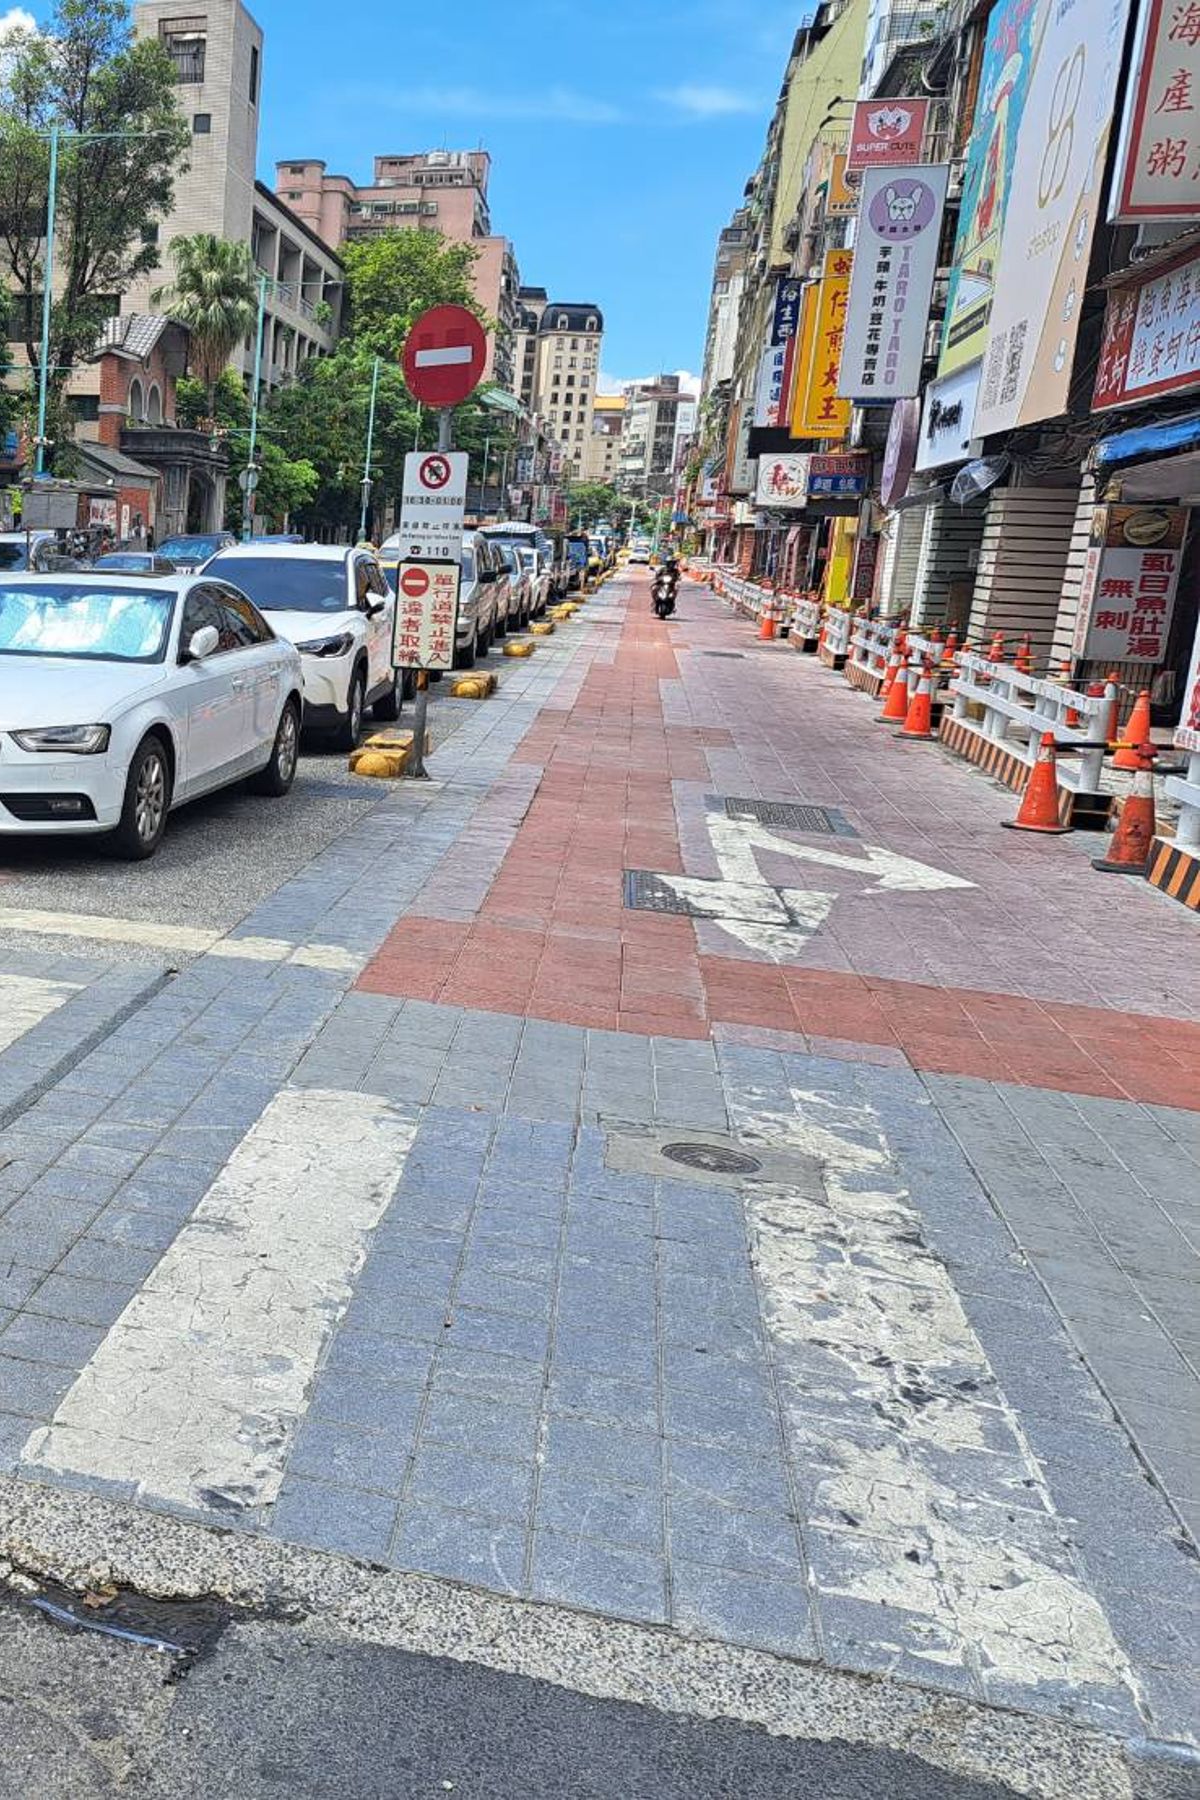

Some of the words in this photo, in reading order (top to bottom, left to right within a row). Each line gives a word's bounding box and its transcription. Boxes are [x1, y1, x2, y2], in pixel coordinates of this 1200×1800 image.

[428, 573, 455, 664] 單行道禁止進入
[1094, 578, 1135, 630] 無刺
[1126, 553, 1175, 657] 虱目魚肚湯
